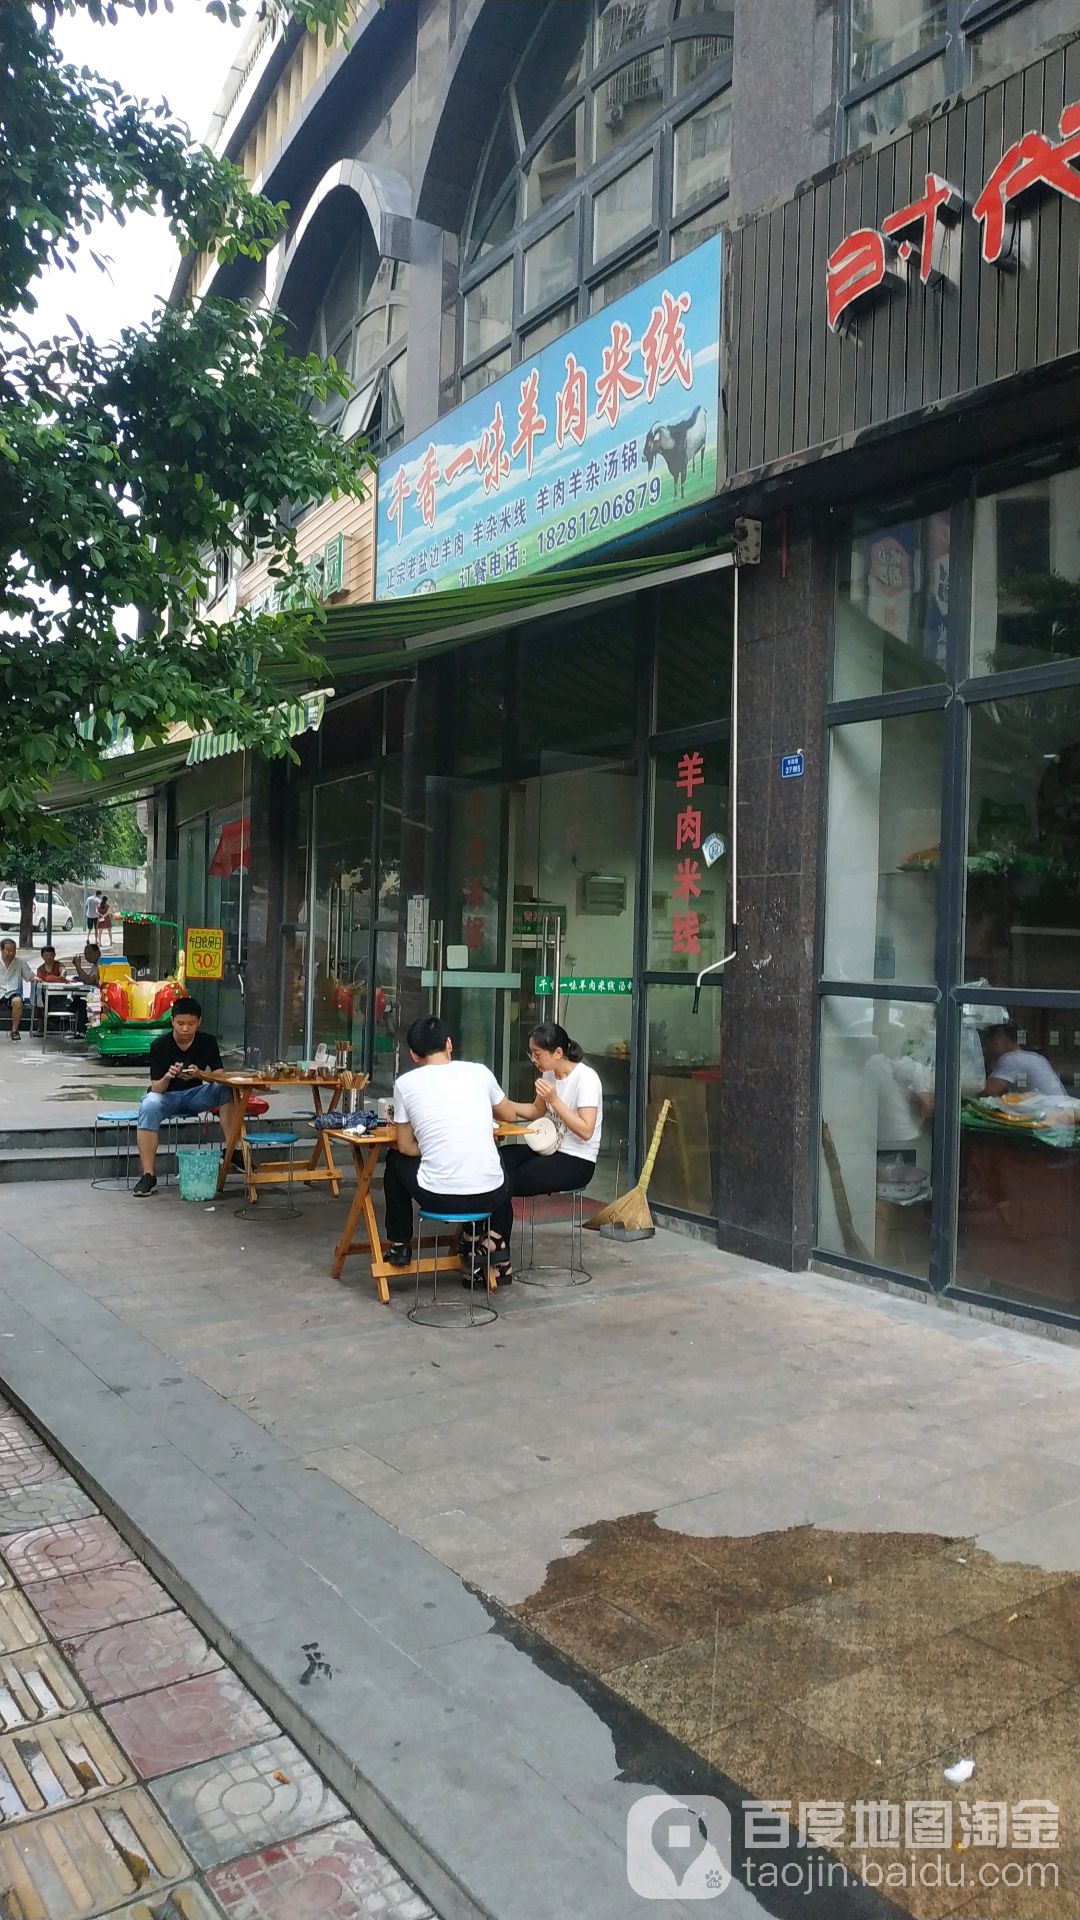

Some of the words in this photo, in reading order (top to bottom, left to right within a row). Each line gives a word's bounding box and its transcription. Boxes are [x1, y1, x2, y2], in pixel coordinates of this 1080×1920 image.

[387, 289, 693, 544] 千香一味羊肉米线
[386, 531, 465, 590] 正宗老盐边羊肉
[472, 497, 528, 547] 羊杂米线
[536, 439, 637, 516] 羊肉羊杂汤锅
[537, 476, 662, 555] 18281206879
[671, 752, 704, 955] 羊肉米线
